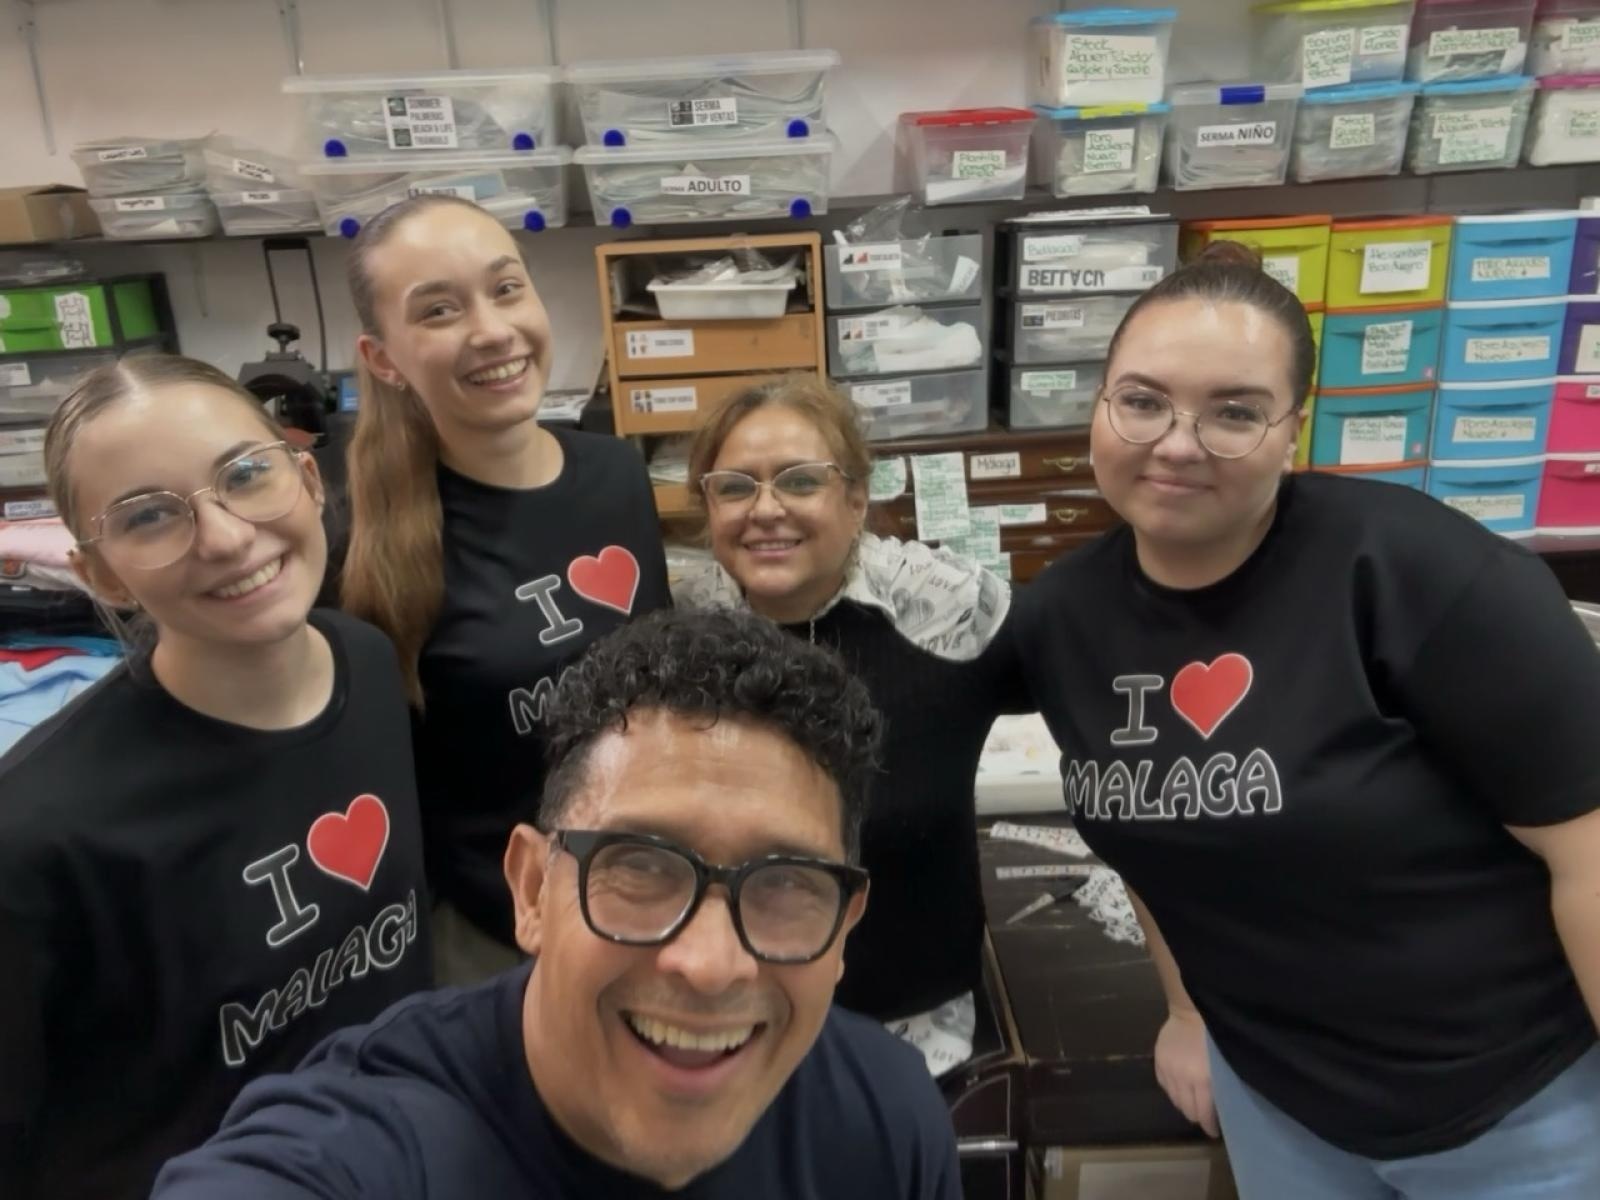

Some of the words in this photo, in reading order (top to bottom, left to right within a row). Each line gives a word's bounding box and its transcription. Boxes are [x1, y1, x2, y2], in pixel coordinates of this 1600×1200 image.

[1200, 132, 1235, 142] SERMA
[1237, 125, 1274, 141] NIÑO
[688, 180, 742, 193] ADULTO
[514, 574, 584, 646] I
[1110, 674, 1164, 745] I
[1065, 747, 1282, 820] MALAGA
[243, 843, 320, 947] I
[220, 888, 417, 1067] MALAGA
